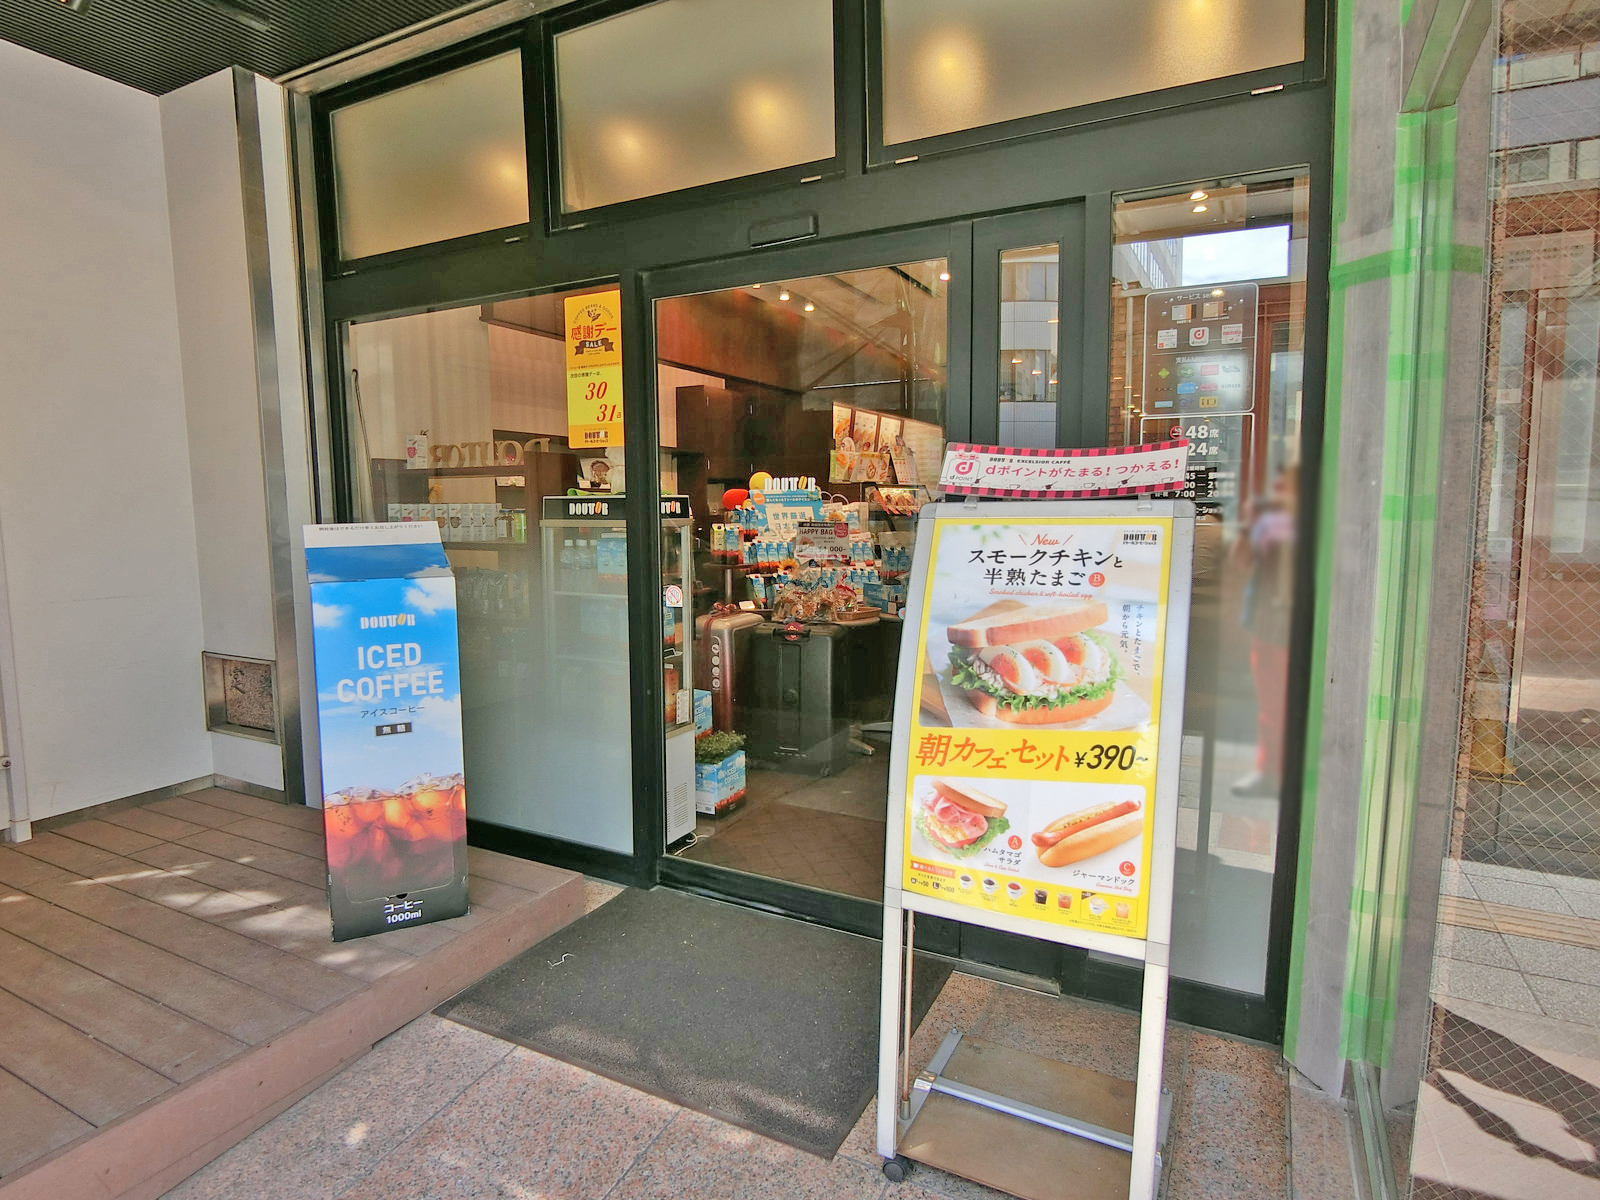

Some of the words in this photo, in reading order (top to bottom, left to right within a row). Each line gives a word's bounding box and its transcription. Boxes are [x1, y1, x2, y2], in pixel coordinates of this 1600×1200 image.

[571, 323, 617, 340] 感謝デー
[585, 340, 602, 348] SALE
[585, 381, 608, 401] 30
[1185, 425, 1219, 439] 48席
[764, 475, 816, 492] DOUTOR
[1174, 490, 1196, 498] 7:00
[568, 501, 609, 516] DOUTOR
[799, 528, 819, 536] HAPPY
[820, 528, 834, 536] BAG
[1030, 533, 1060, 546] New
[968, 548, 1123, 569] スモークチキンと
[983, 568, 1086, 587] 半熟たまご
[988, 588, 1014, 596] Smoked
[360, 613, 416, 630] DOUTOR
[357, 642, 422, 671] ICED
[337, 670, 445, 703] COFFEE
[360, 705, 425, 719] アイスコーヒー
[983, 847, 1022, 858] ハムタマゴ
[998, 857, 1021, 865] サラダ
[383, 900, 424, 914] コーヒー
[385, 909, 422, 924] 1000ml
